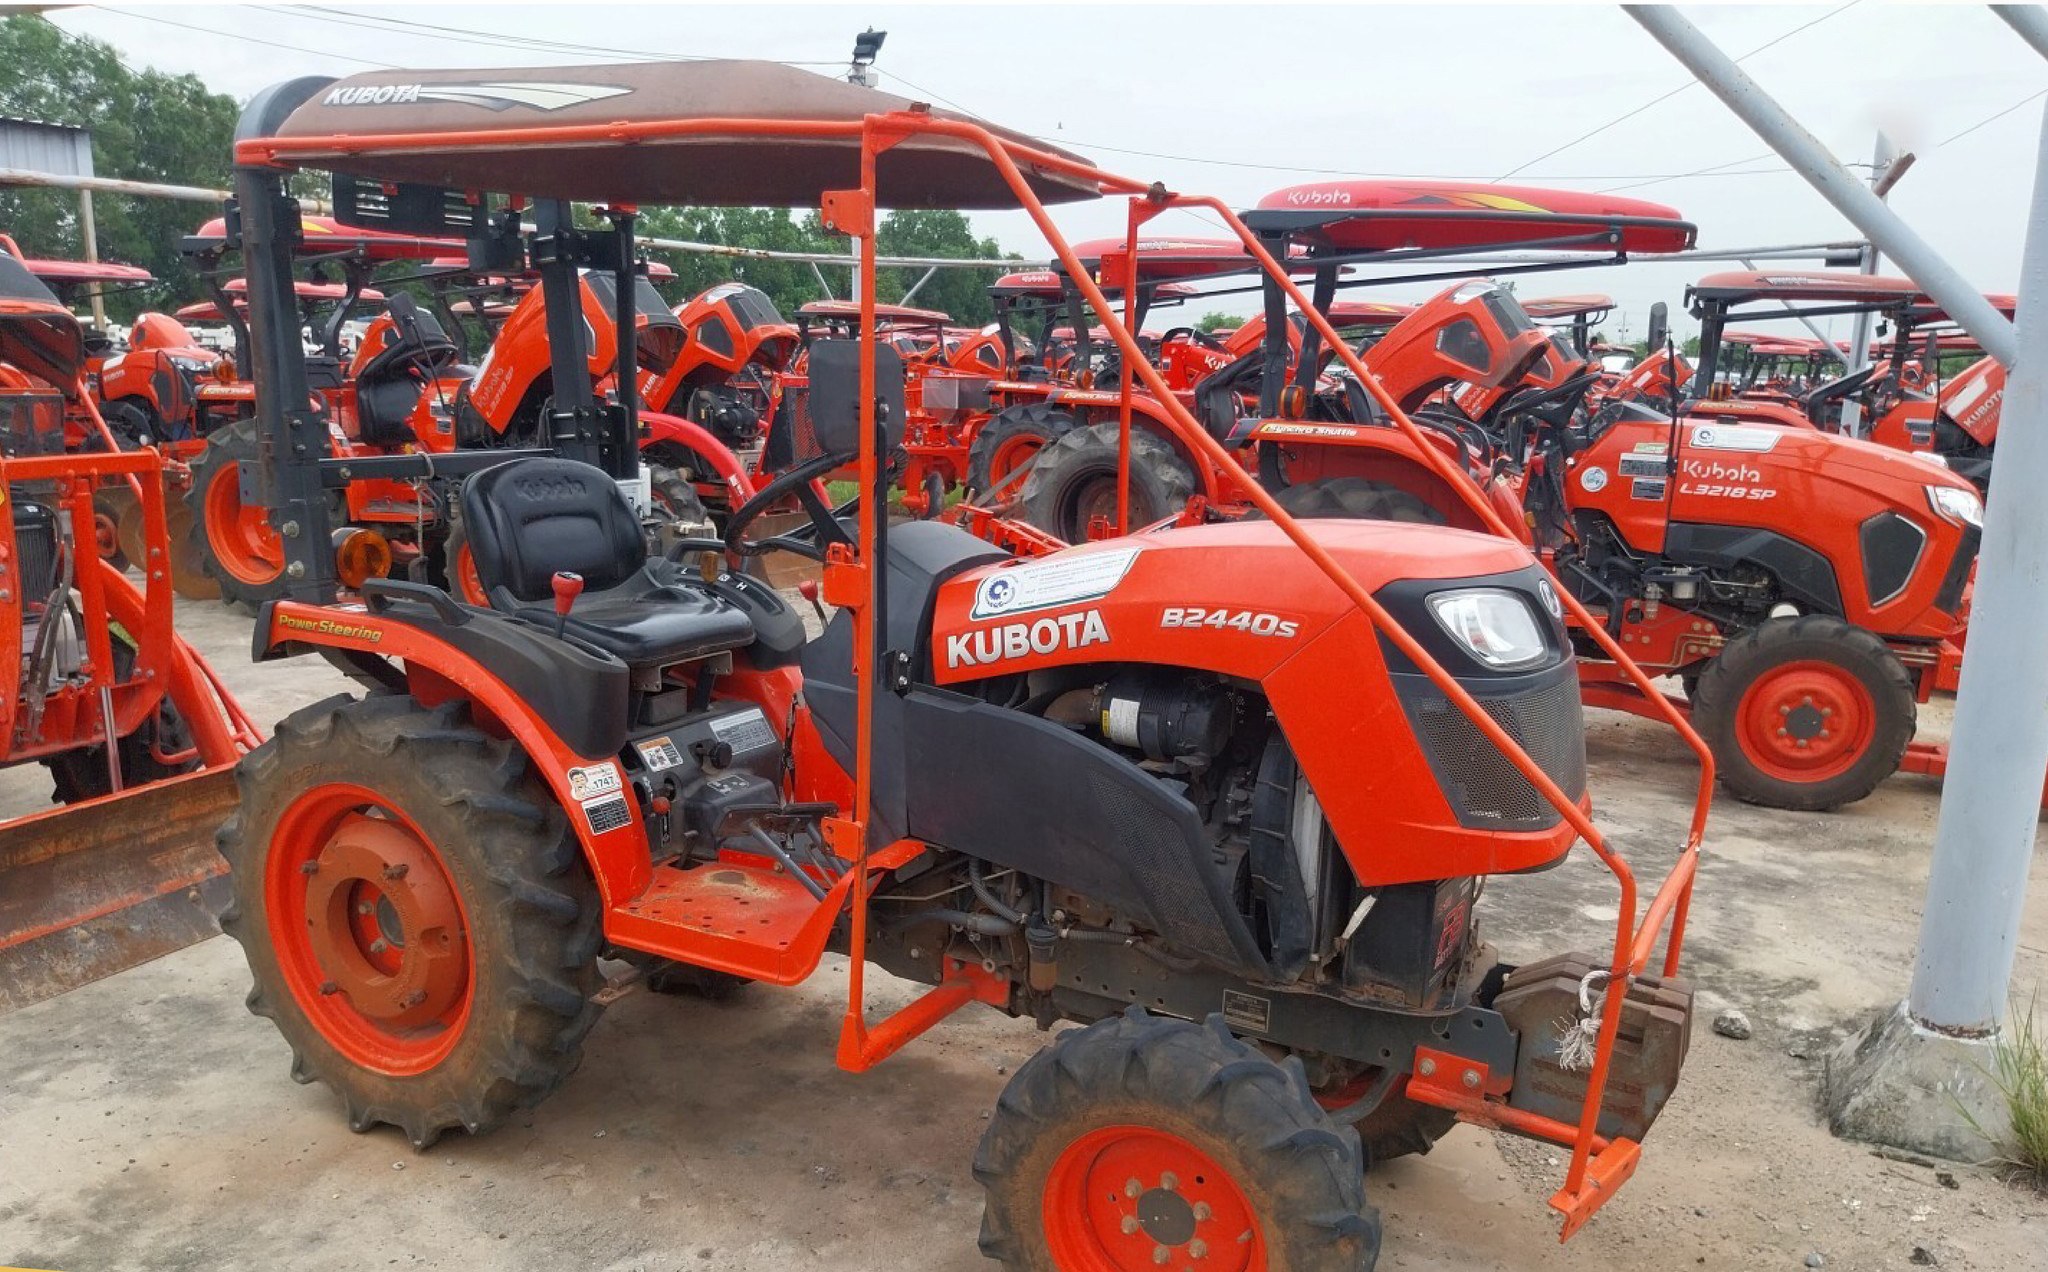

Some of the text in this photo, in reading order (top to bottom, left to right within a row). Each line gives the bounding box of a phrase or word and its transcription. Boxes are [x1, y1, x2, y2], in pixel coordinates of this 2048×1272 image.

[323, 84, 422, 105] KUBOTA
[1287, 189, 1351, 205] Kubota
[1682, 459, 1761, 483] Kubota
[1679, 482, 1748, 499] L3218
[1746, 488, 1777, 501] SP
[279, 614, 383, 643] Power Steering
[946, 609, 1110, 670] KUBOTA
[593, 776, 614, 788] 1747
